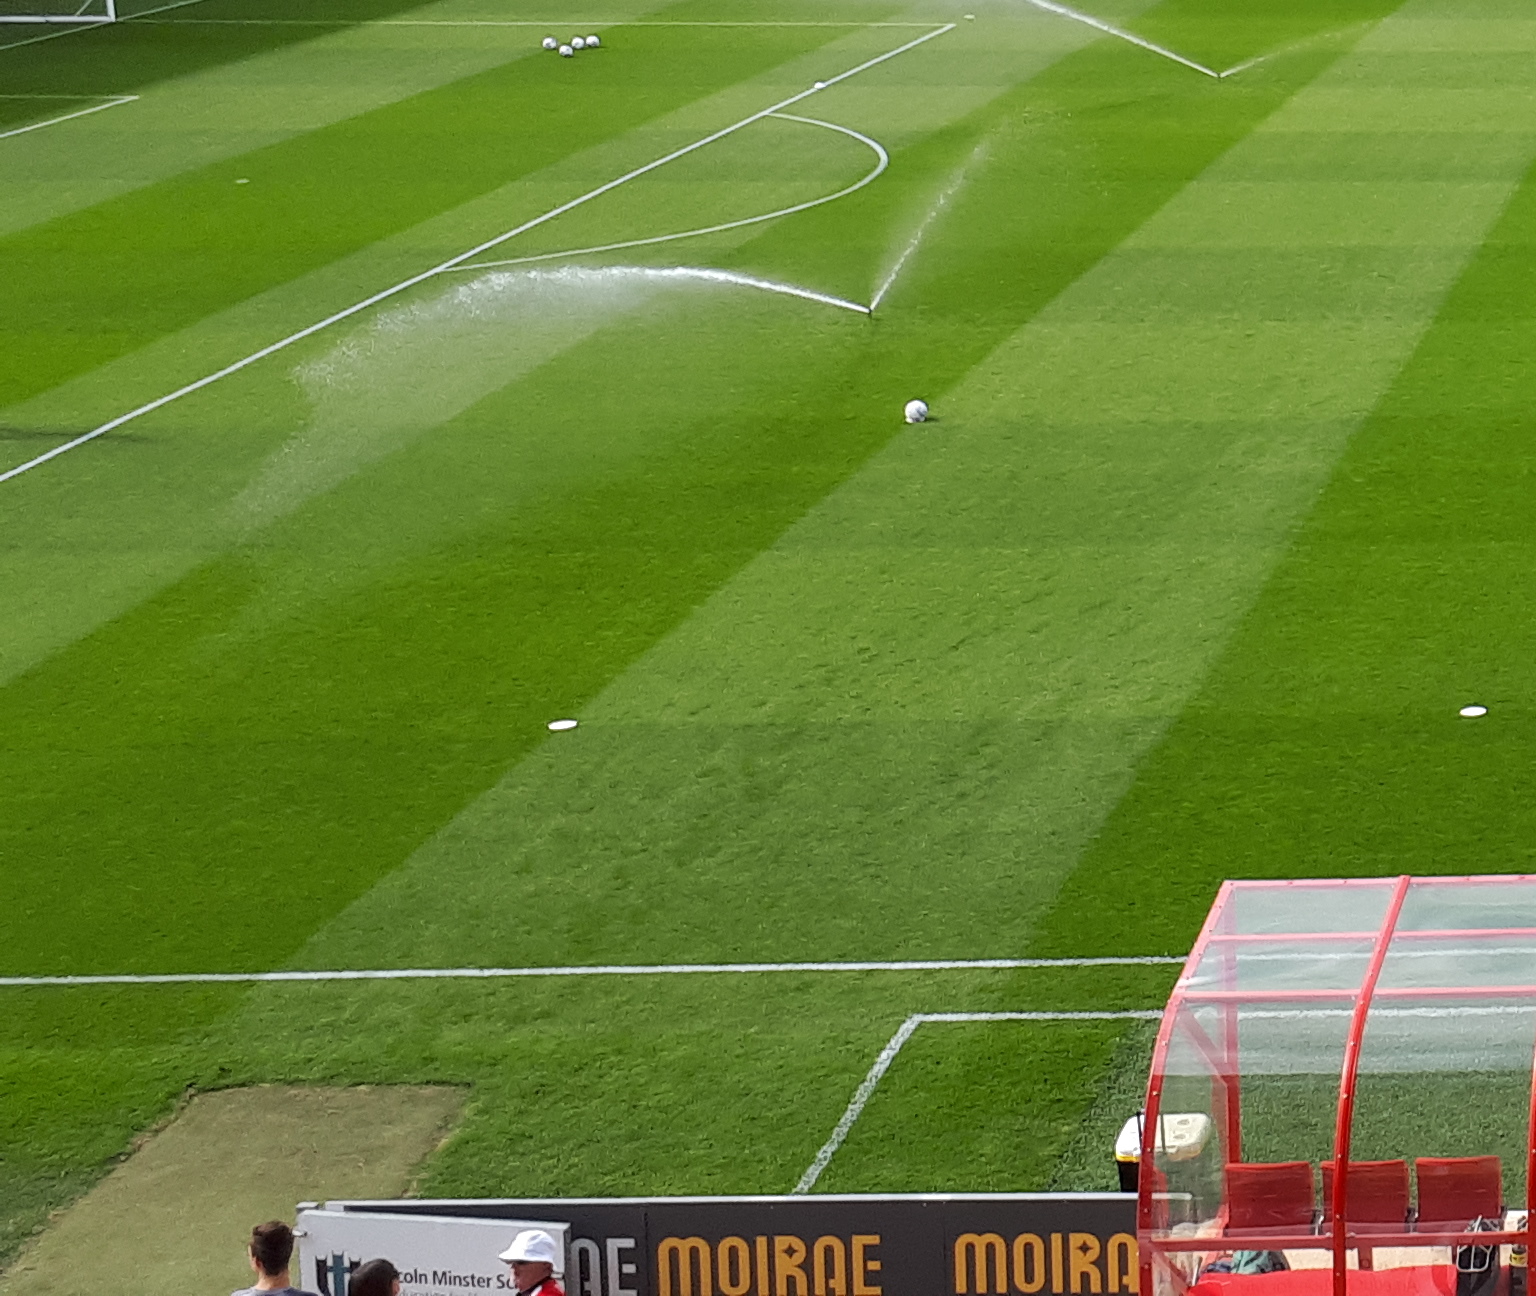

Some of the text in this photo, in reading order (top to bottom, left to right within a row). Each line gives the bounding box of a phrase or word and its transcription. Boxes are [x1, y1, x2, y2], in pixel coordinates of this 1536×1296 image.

[432, 1272, 492, 1290] Minster
[659, 1235, 881, 1296] MOIRAE
[954, 1232, 1140, 1295] MOIRA
